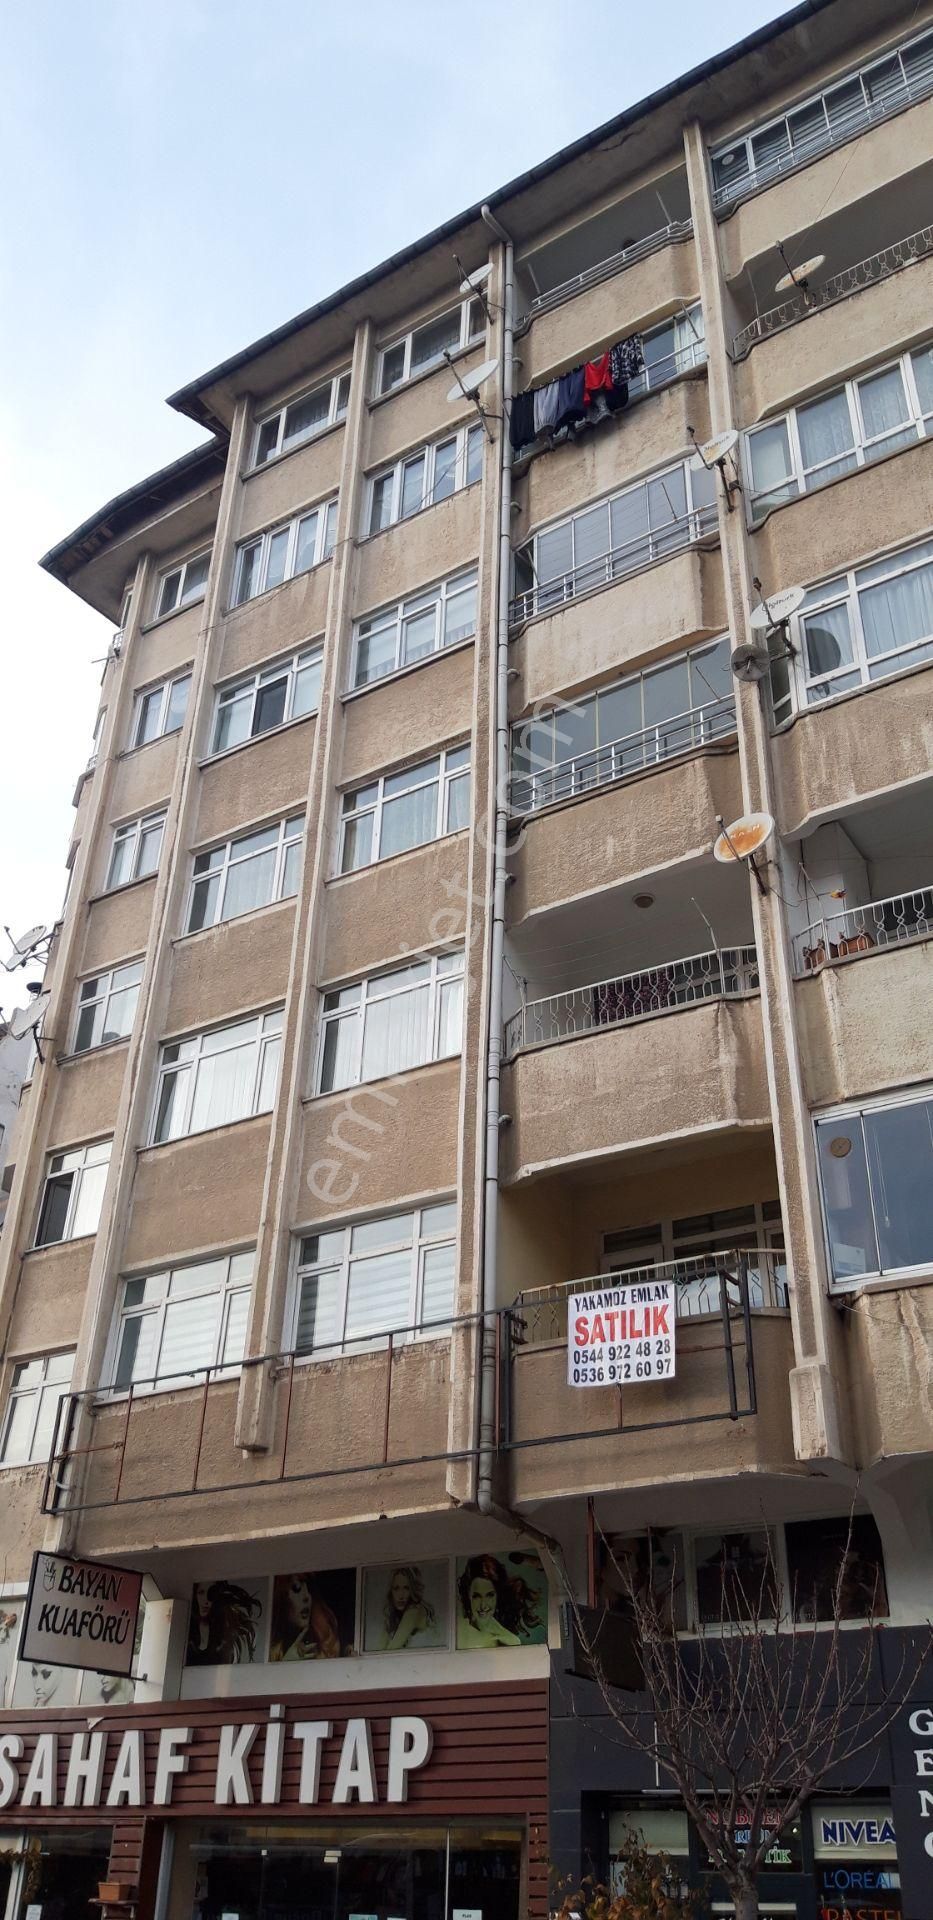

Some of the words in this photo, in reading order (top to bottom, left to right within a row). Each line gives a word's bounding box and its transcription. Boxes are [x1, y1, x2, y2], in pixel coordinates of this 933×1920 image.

[575, 1290, 627, 1312] YAKAMOZ
[631, 1284, 669, 1304] EMLAK
[575, 1305, 670, 1346] SATILIK
[574, 1347, 604, 1365] 0544
[608, 1344, 631, 1361] 922
[636, 1341, 651, 1357] 48
[656, 1338, 671, 1355] 28
[573, 1367, 605, 1383] 0536
[608, 1363, 631, 1380] 972
[636, 1361, 652, 1377] 60
[656, 1358, 672, 1375] 97
[58, 1565, 123, 1602] BAYAN
[37, 1603, 131, 1645] KUAFÖRÜ
[0, 1727, 195, 1807] SAHAF
[215, 1703, 434, 1804] KİTAP
[821, 1817, 896, 1847] NIVEA
